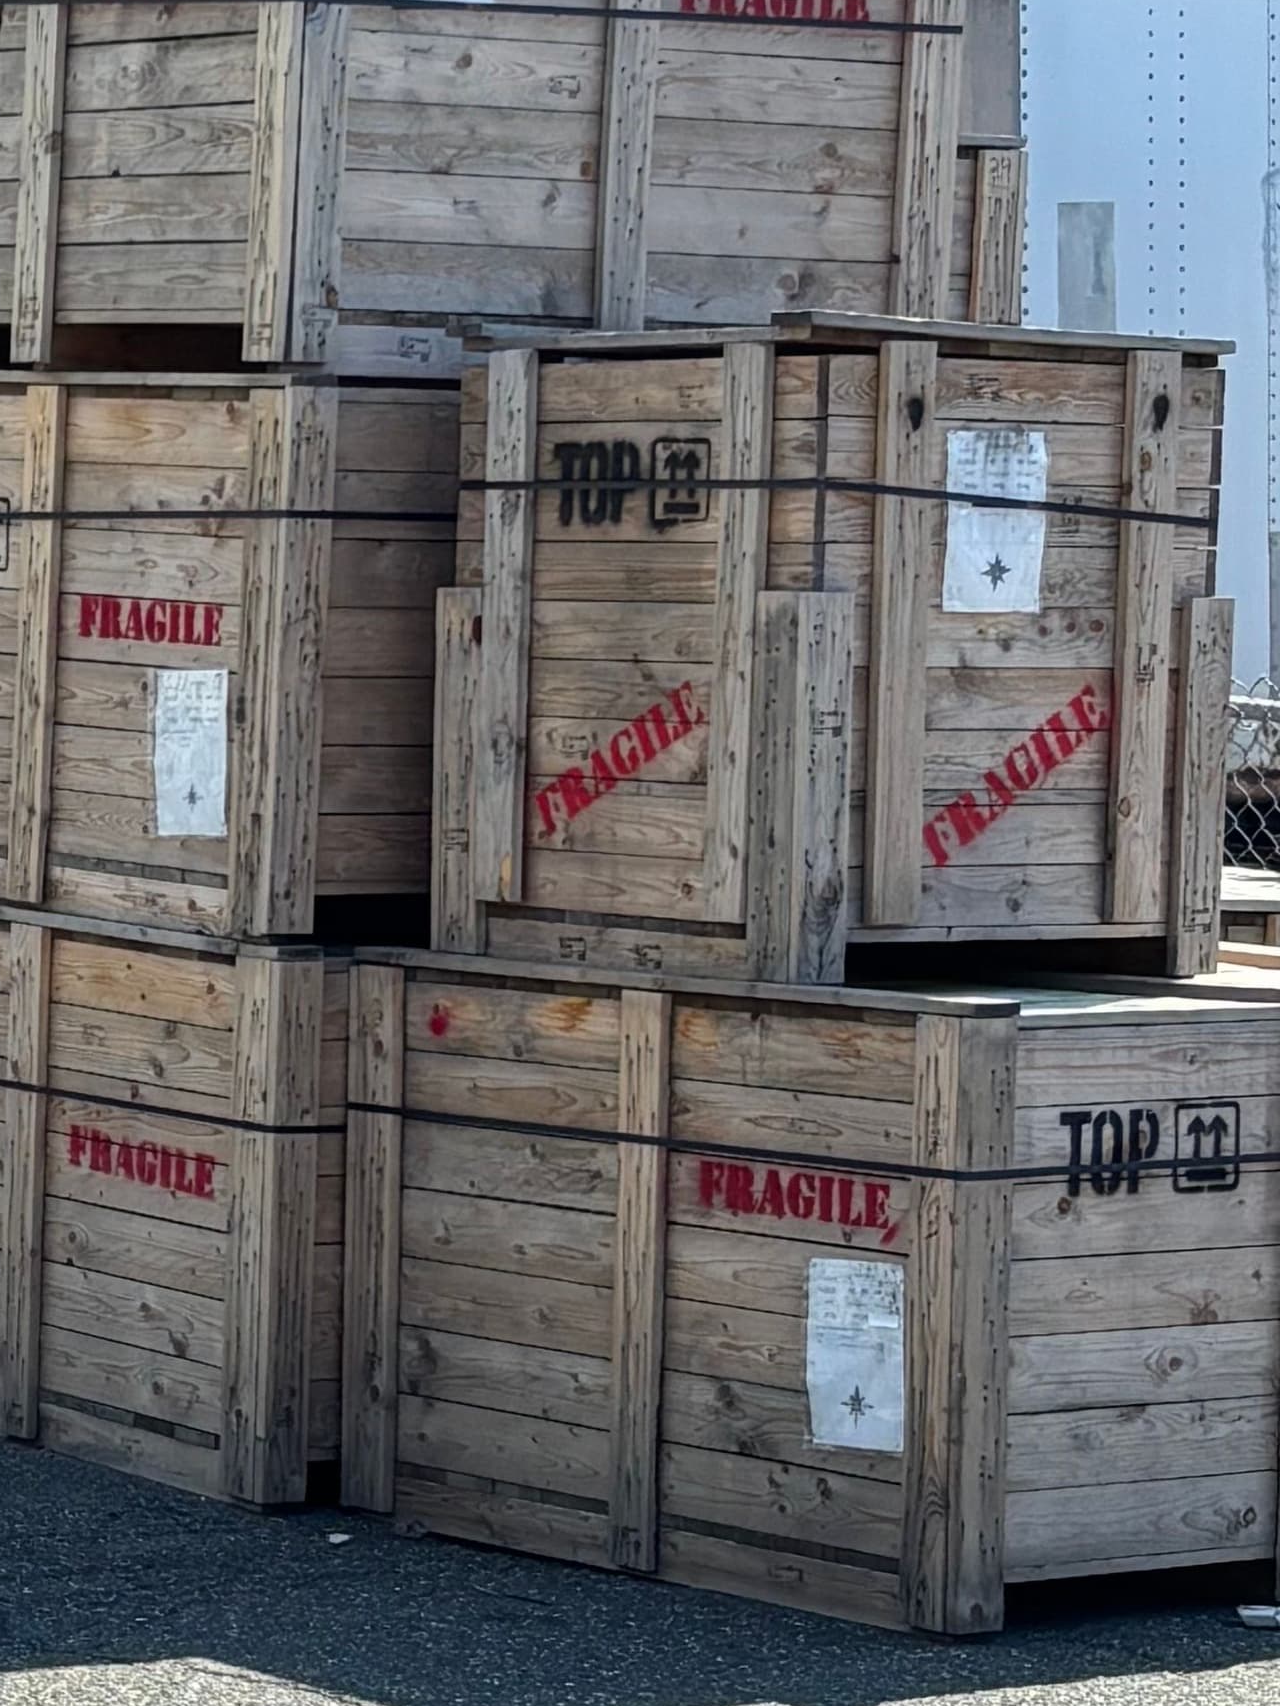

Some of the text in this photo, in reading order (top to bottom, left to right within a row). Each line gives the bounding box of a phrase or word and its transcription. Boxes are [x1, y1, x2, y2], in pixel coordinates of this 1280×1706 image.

[554, 441, 642, 527] TOP
[78, 595, 224, 647] FRAGILE
[532, 680, 708, 839] FRAGILE
[922, 684, 1110, 868] FRAGILE
[68, 1123, 216, 1201] FRAGILE
[698, 1158, 892, 1231] FRAGILE
[1059, 1110, 1161, 1198] TOP
